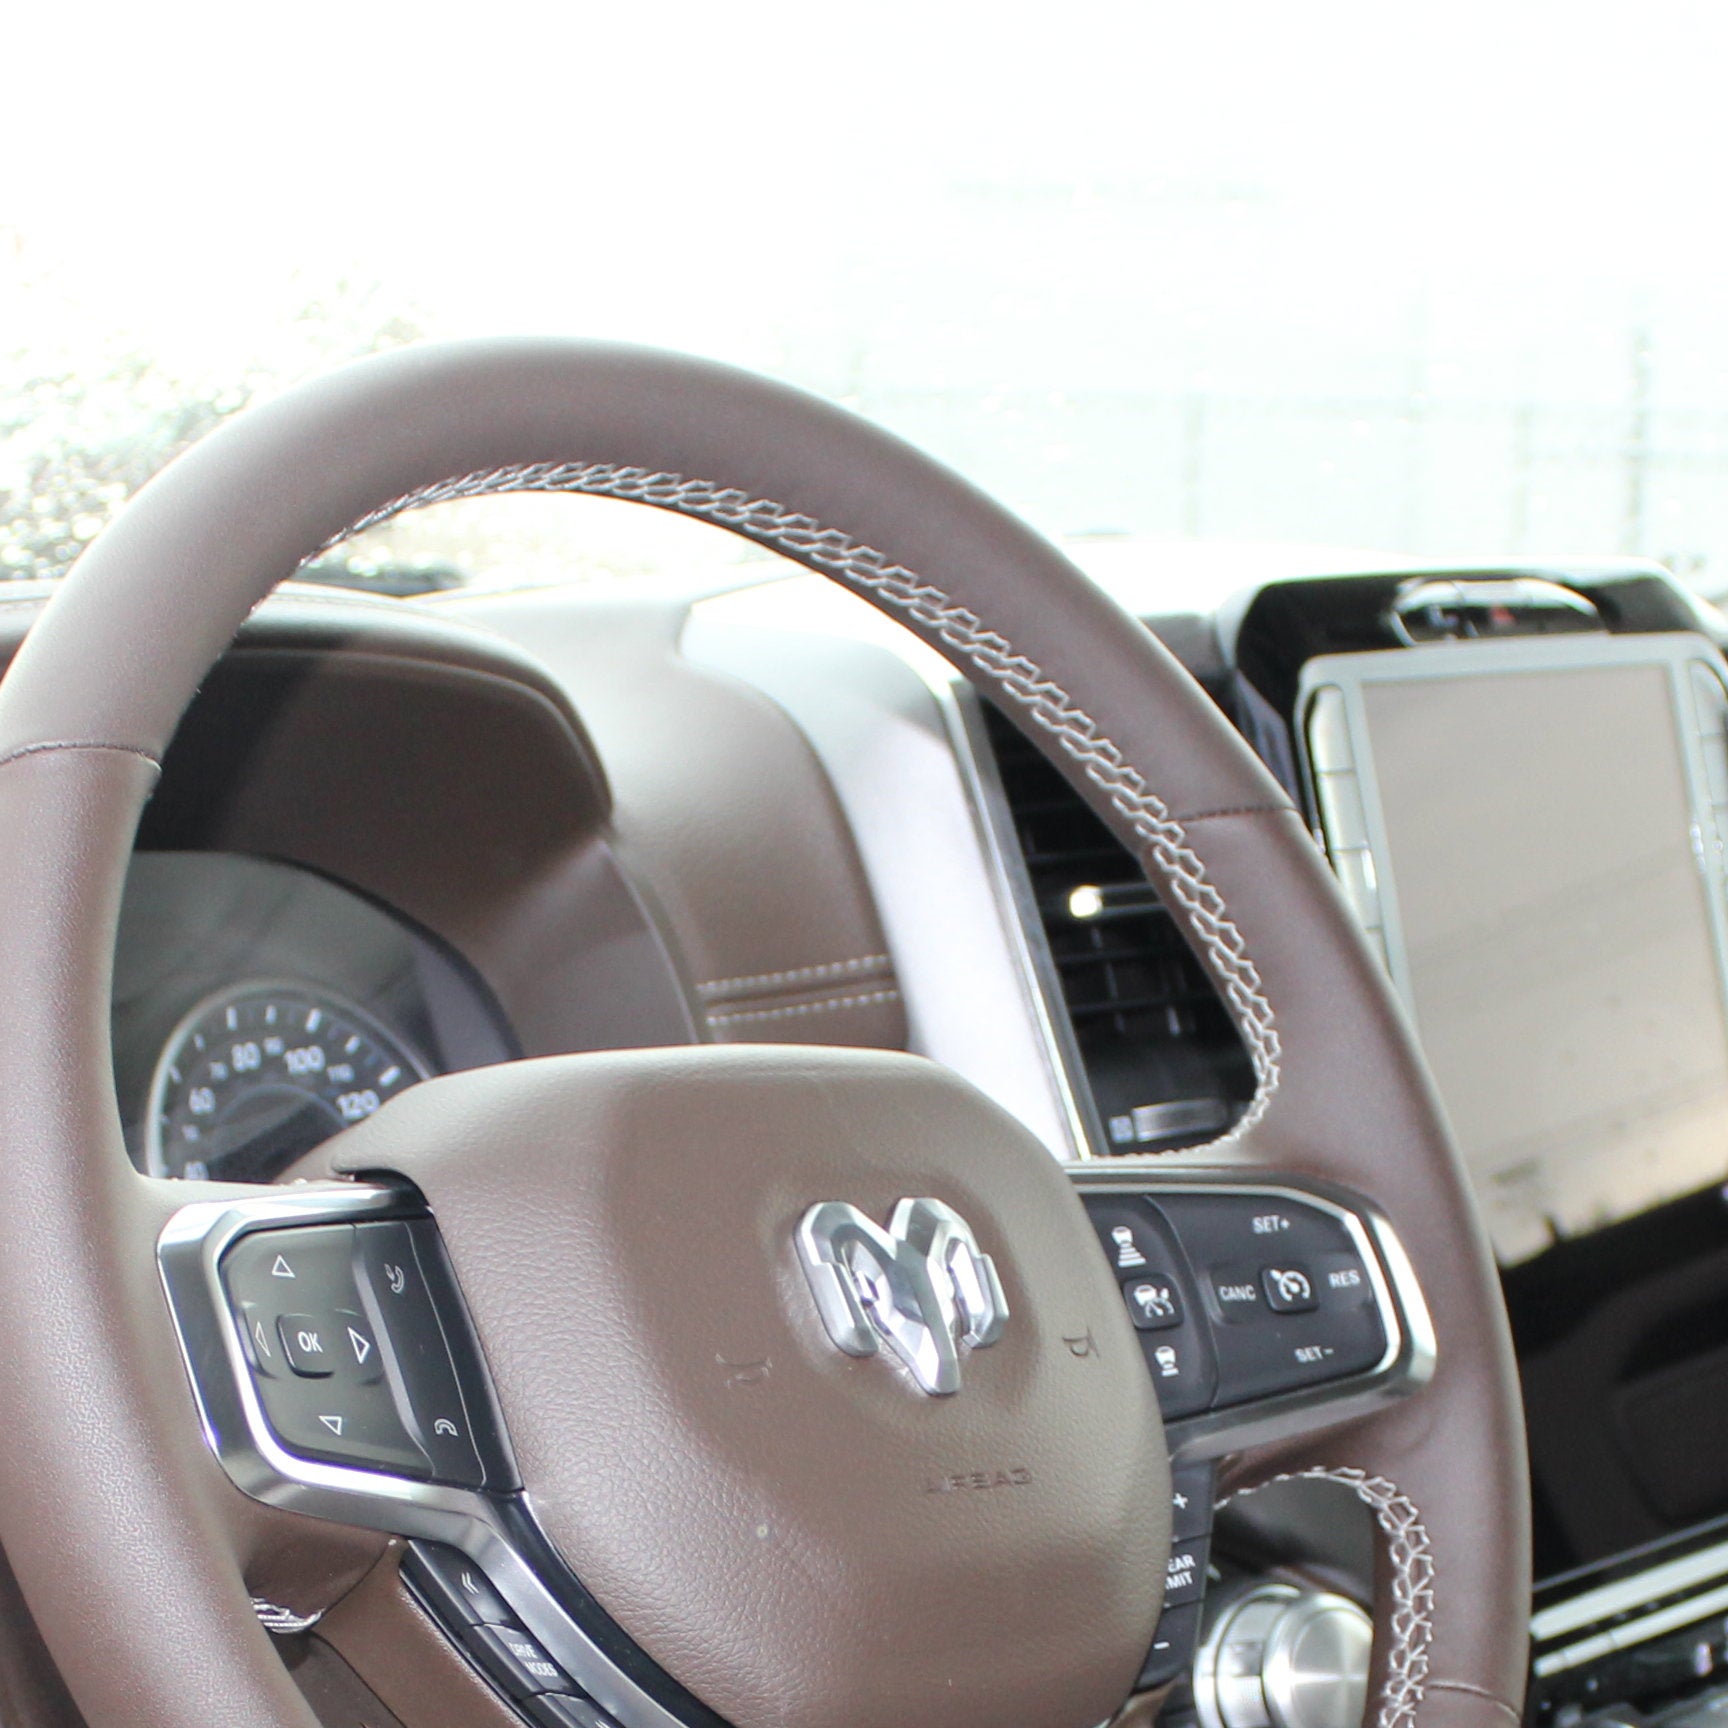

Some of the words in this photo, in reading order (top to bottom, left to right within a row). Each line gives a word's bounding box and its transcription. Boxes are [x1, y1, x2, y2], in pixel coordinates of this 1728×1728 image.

[1329, 1270, 1360, 1288] RES
[1219, 1286, 1256, 1300] CANC
[299, 1331, 323, 1352] OK
[1168, 1554, 1195, 1572] EAR
